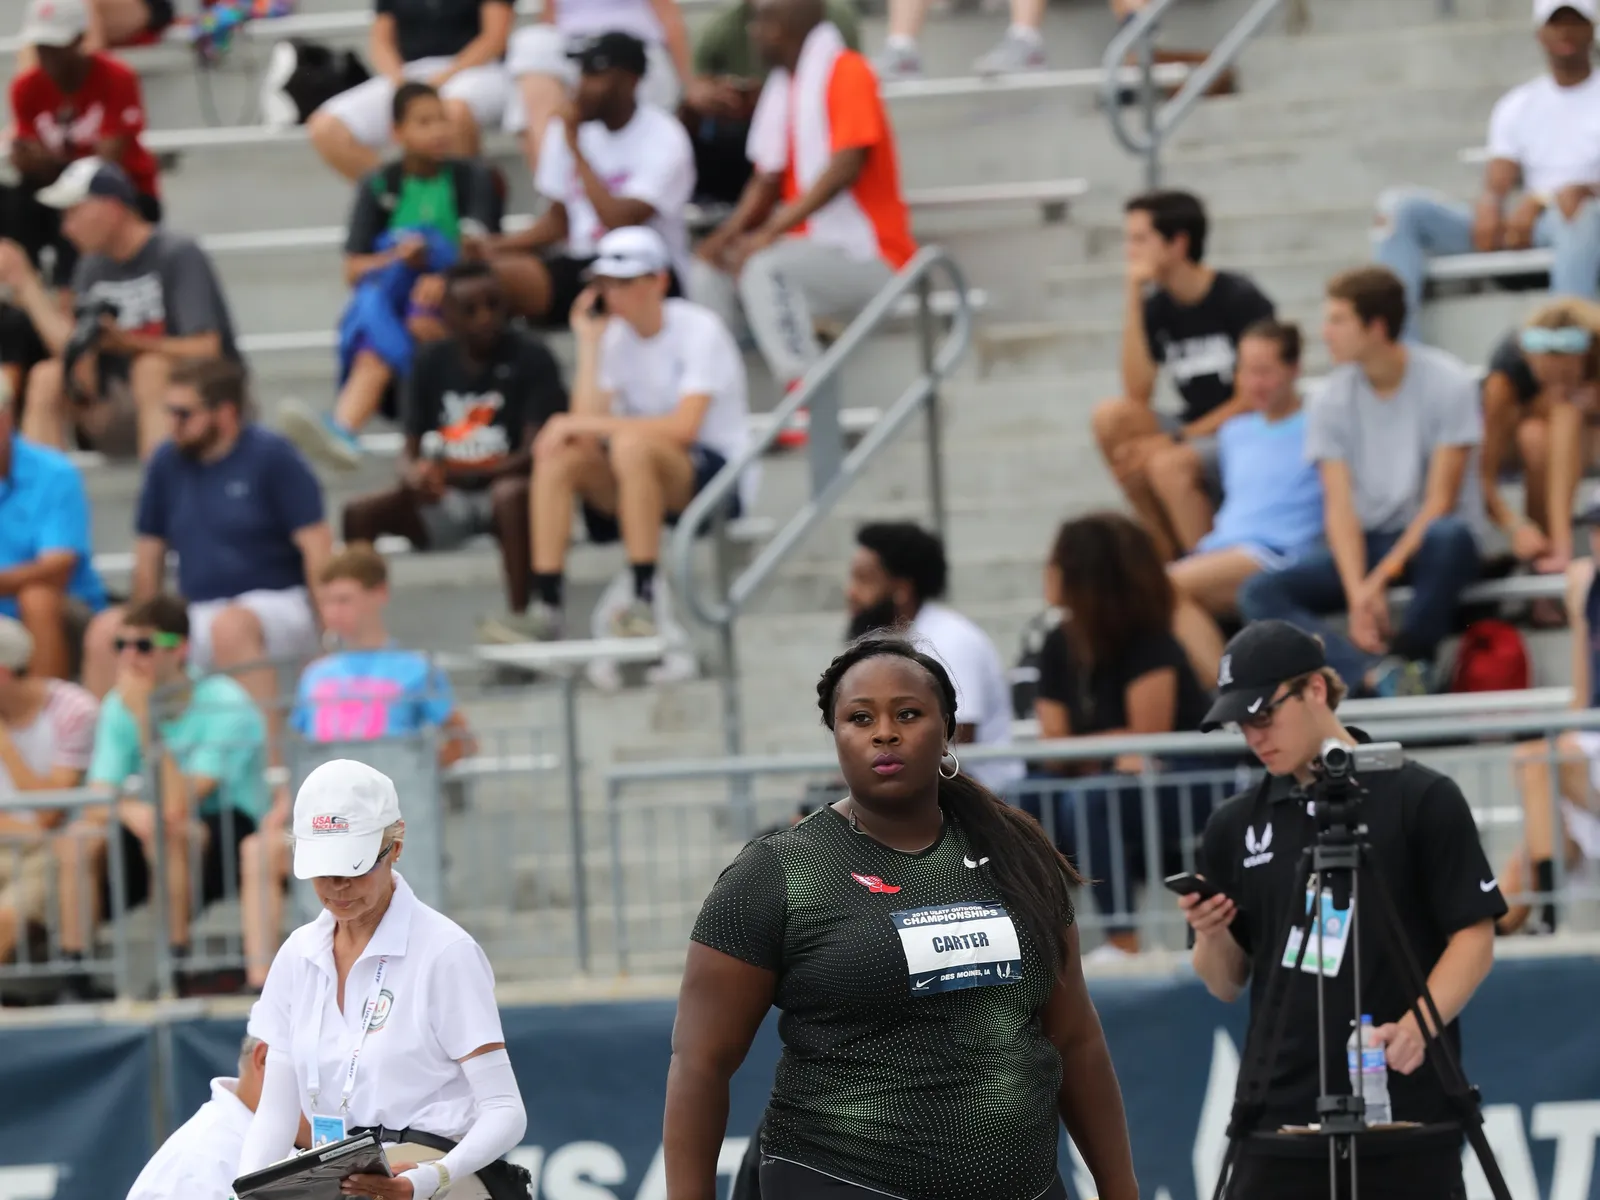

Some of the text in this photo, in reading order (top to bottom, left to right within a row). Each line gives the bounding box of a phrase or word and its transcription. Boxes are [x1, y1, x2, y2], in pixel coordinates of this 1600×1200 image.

[312, 816, 331, 825] USA
[902, 909, 998, 925] CHAMPIONSHIPS
[932, 931, 989, 953] CARTER
[956, 969, 983, 978] MOINES,
